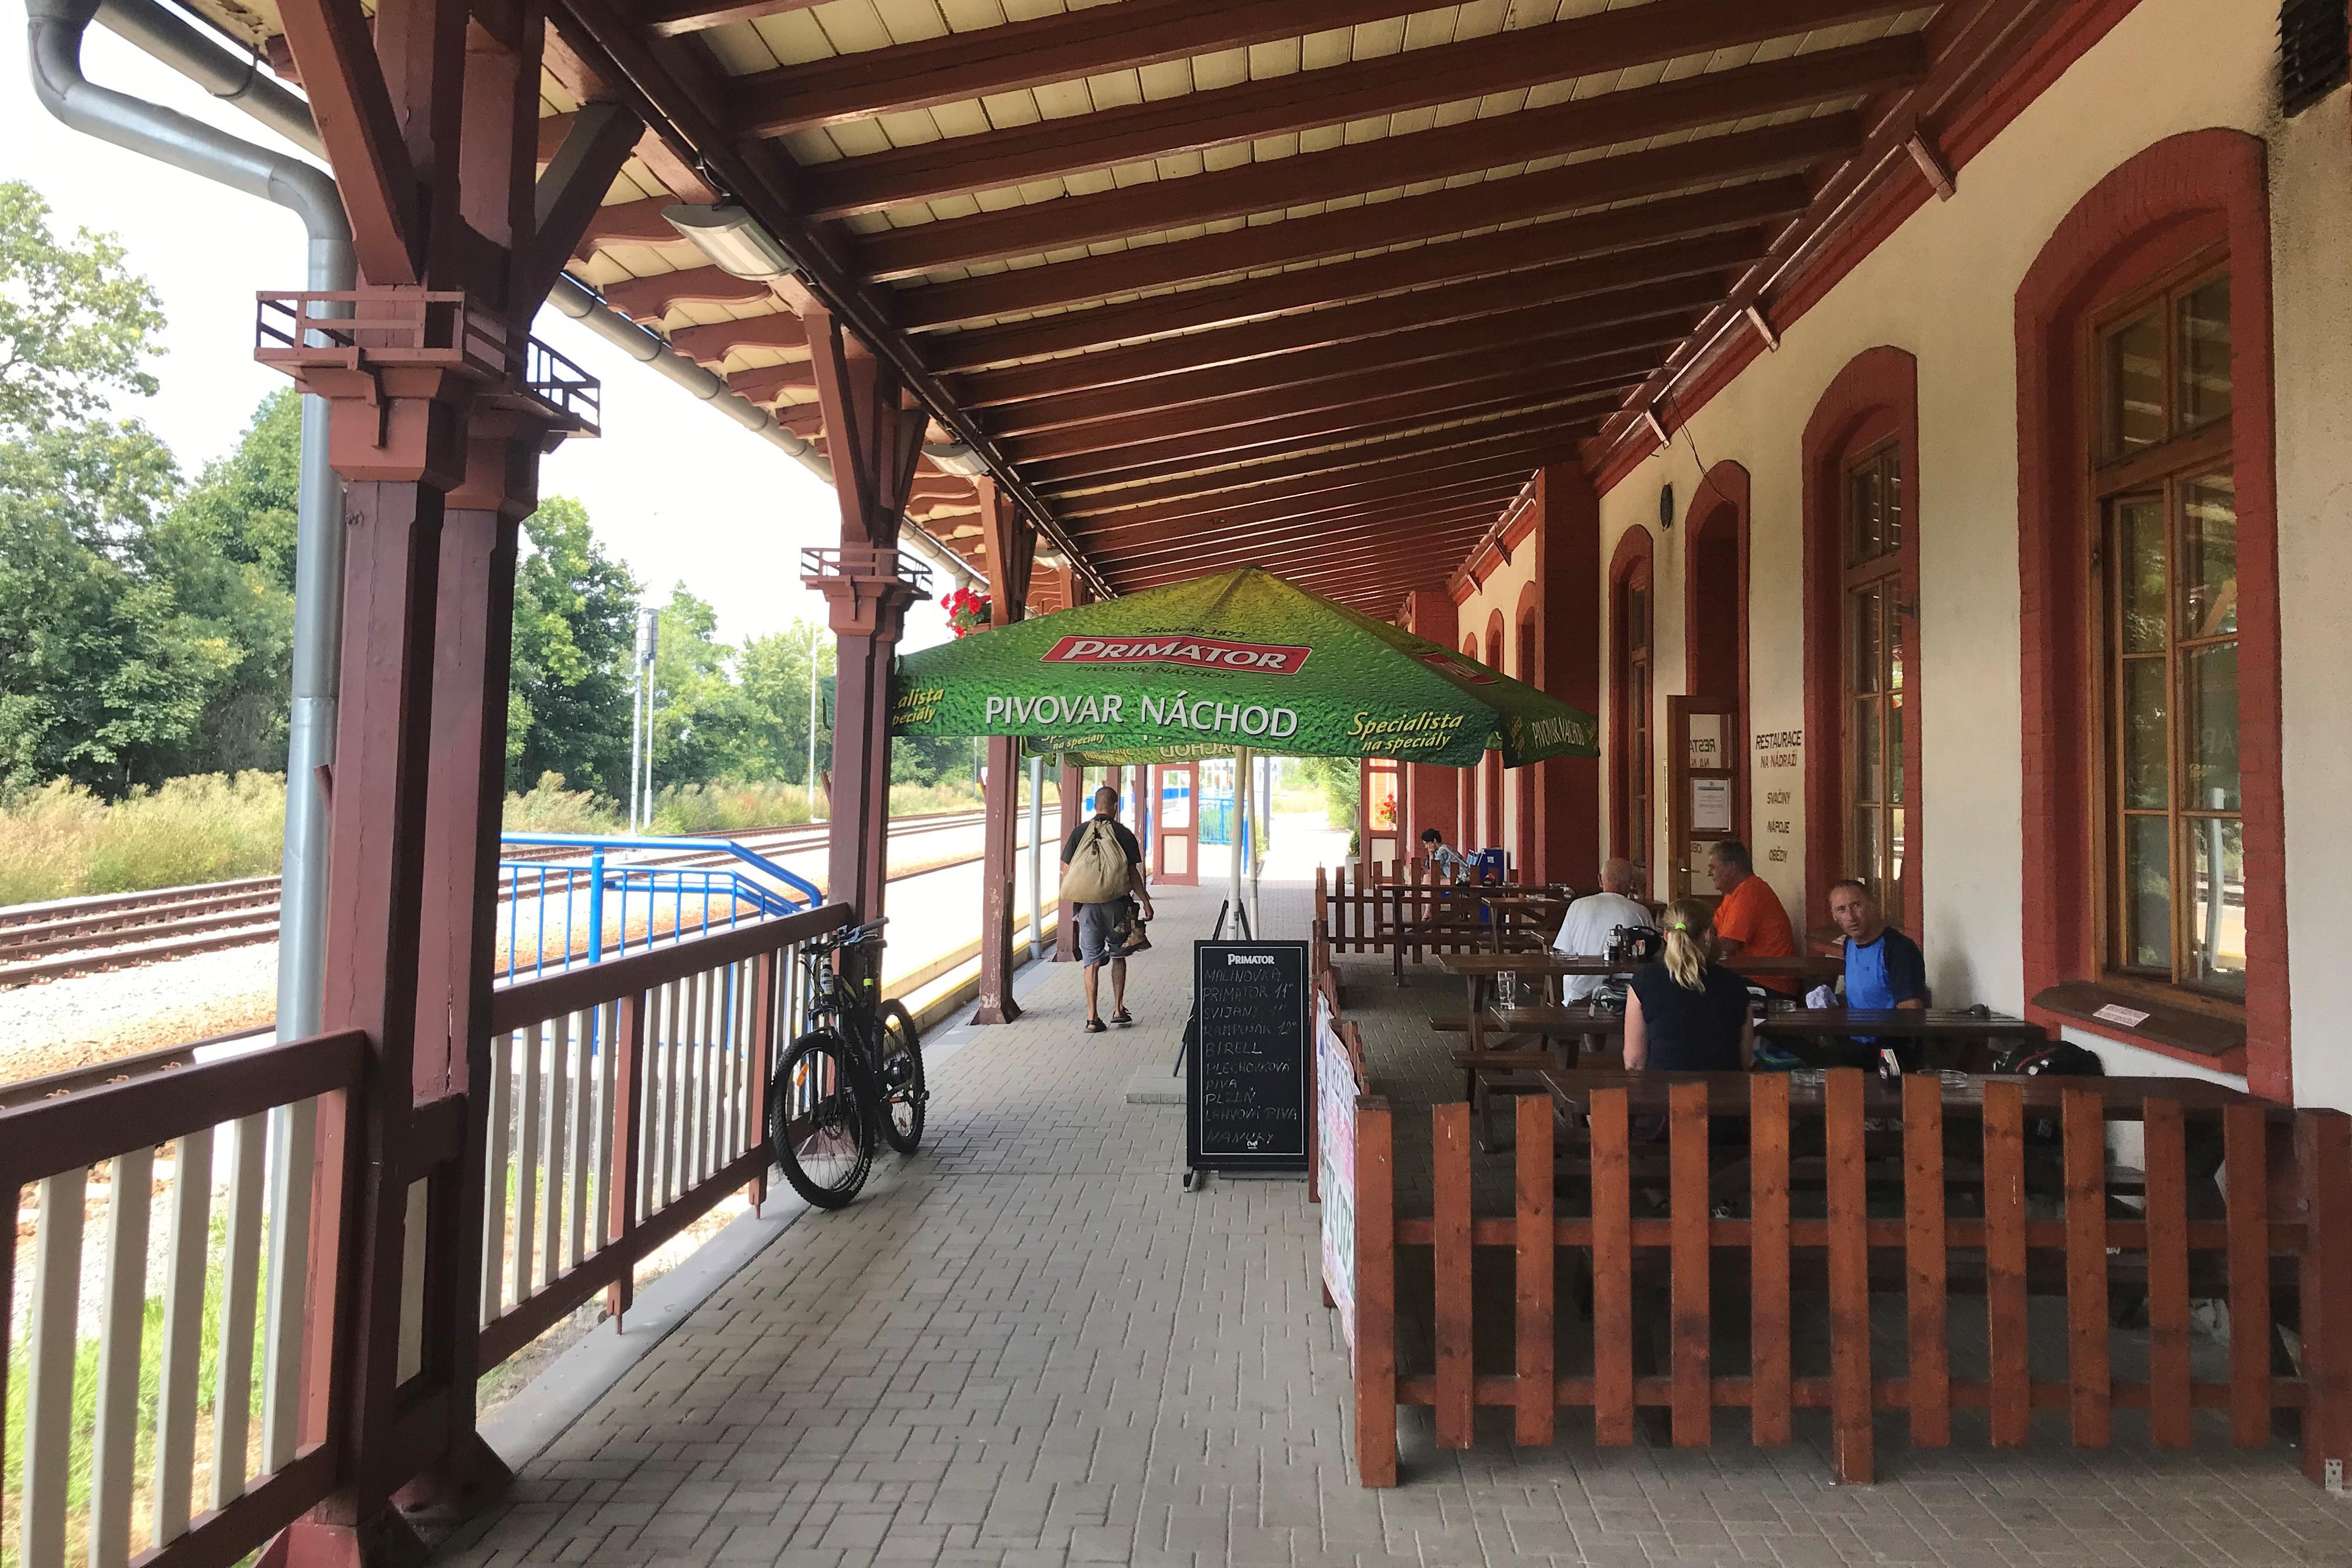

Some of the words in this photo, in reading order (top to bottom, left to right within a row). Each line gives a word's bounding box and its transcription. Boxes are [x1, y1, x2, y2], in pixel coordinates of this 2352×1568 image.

[1210, 628, 1245, 638] 1872
[893, 688, 944, 709] alista
[985, 694, 1123, 724] PIVOVAR
[1141, 690, 1298, 737] NÁCHOD
[1347, 711, 1464, 740] Specialista
[1361, 740, 1382, 751] na
[1385, 731, 1451, 754] speciály
[1756, 730, 1802, 749] RESTAURACE
[1760, 755, 1769, 768] NA
[1205, 1042, 1262, 1057] BIRELL
